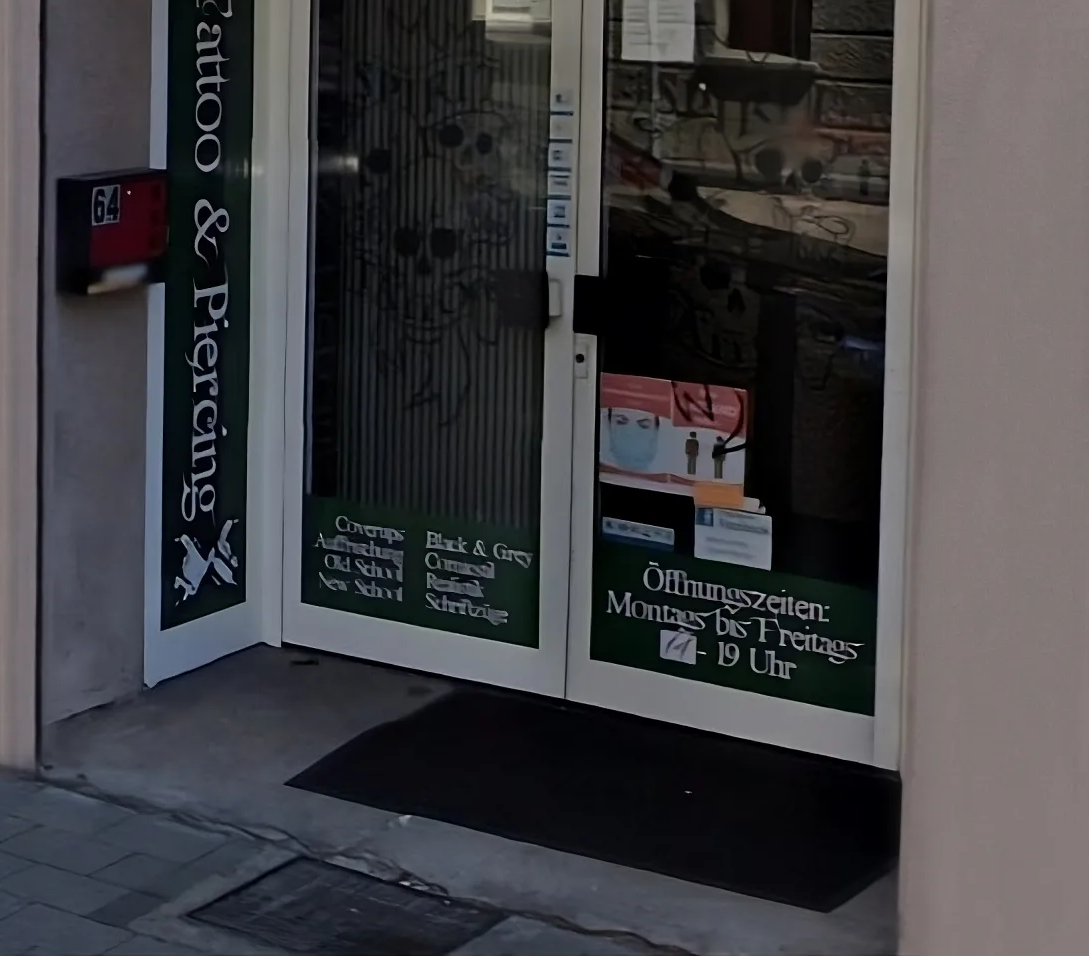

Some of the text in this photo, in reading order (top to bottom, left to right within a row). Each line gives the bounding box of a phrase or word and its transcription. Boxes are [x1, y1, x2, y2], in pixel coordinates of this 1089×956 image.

[93, 186, 119, 224] 64
[194, 198, 230, 268] &
[181, 263, 230, 527] Piercing
[472, 539, 489, 558] &
[606, 590, 864, 664] Montags bis Freitags
[718, 641, 740, 667] 19
[749, 647, 798, 680] Uhr
